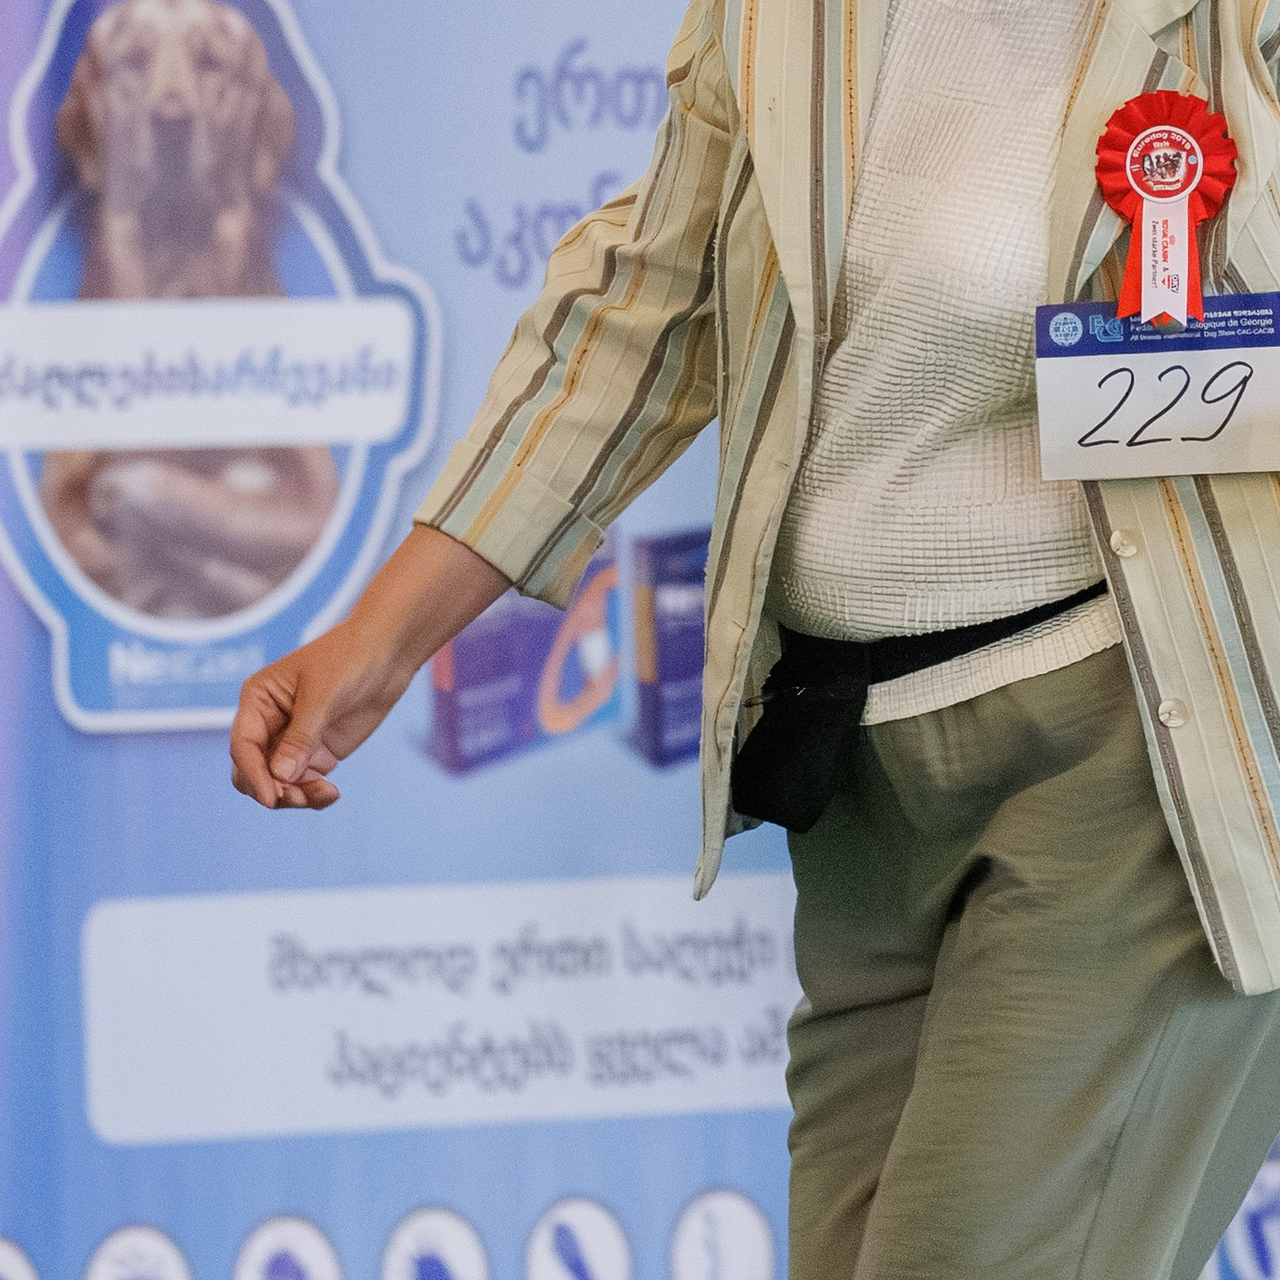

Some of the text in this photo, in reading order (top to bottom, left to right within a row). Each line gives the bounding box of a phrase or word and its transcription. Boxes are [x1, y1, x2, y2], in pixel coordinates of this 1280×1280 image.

[1227, 318, 1239, 327] de
[1203, 330, 1217, 338] Dog
[1218, 329, 1235, 337] Show
[1077, 361, 1254, 447] 229
